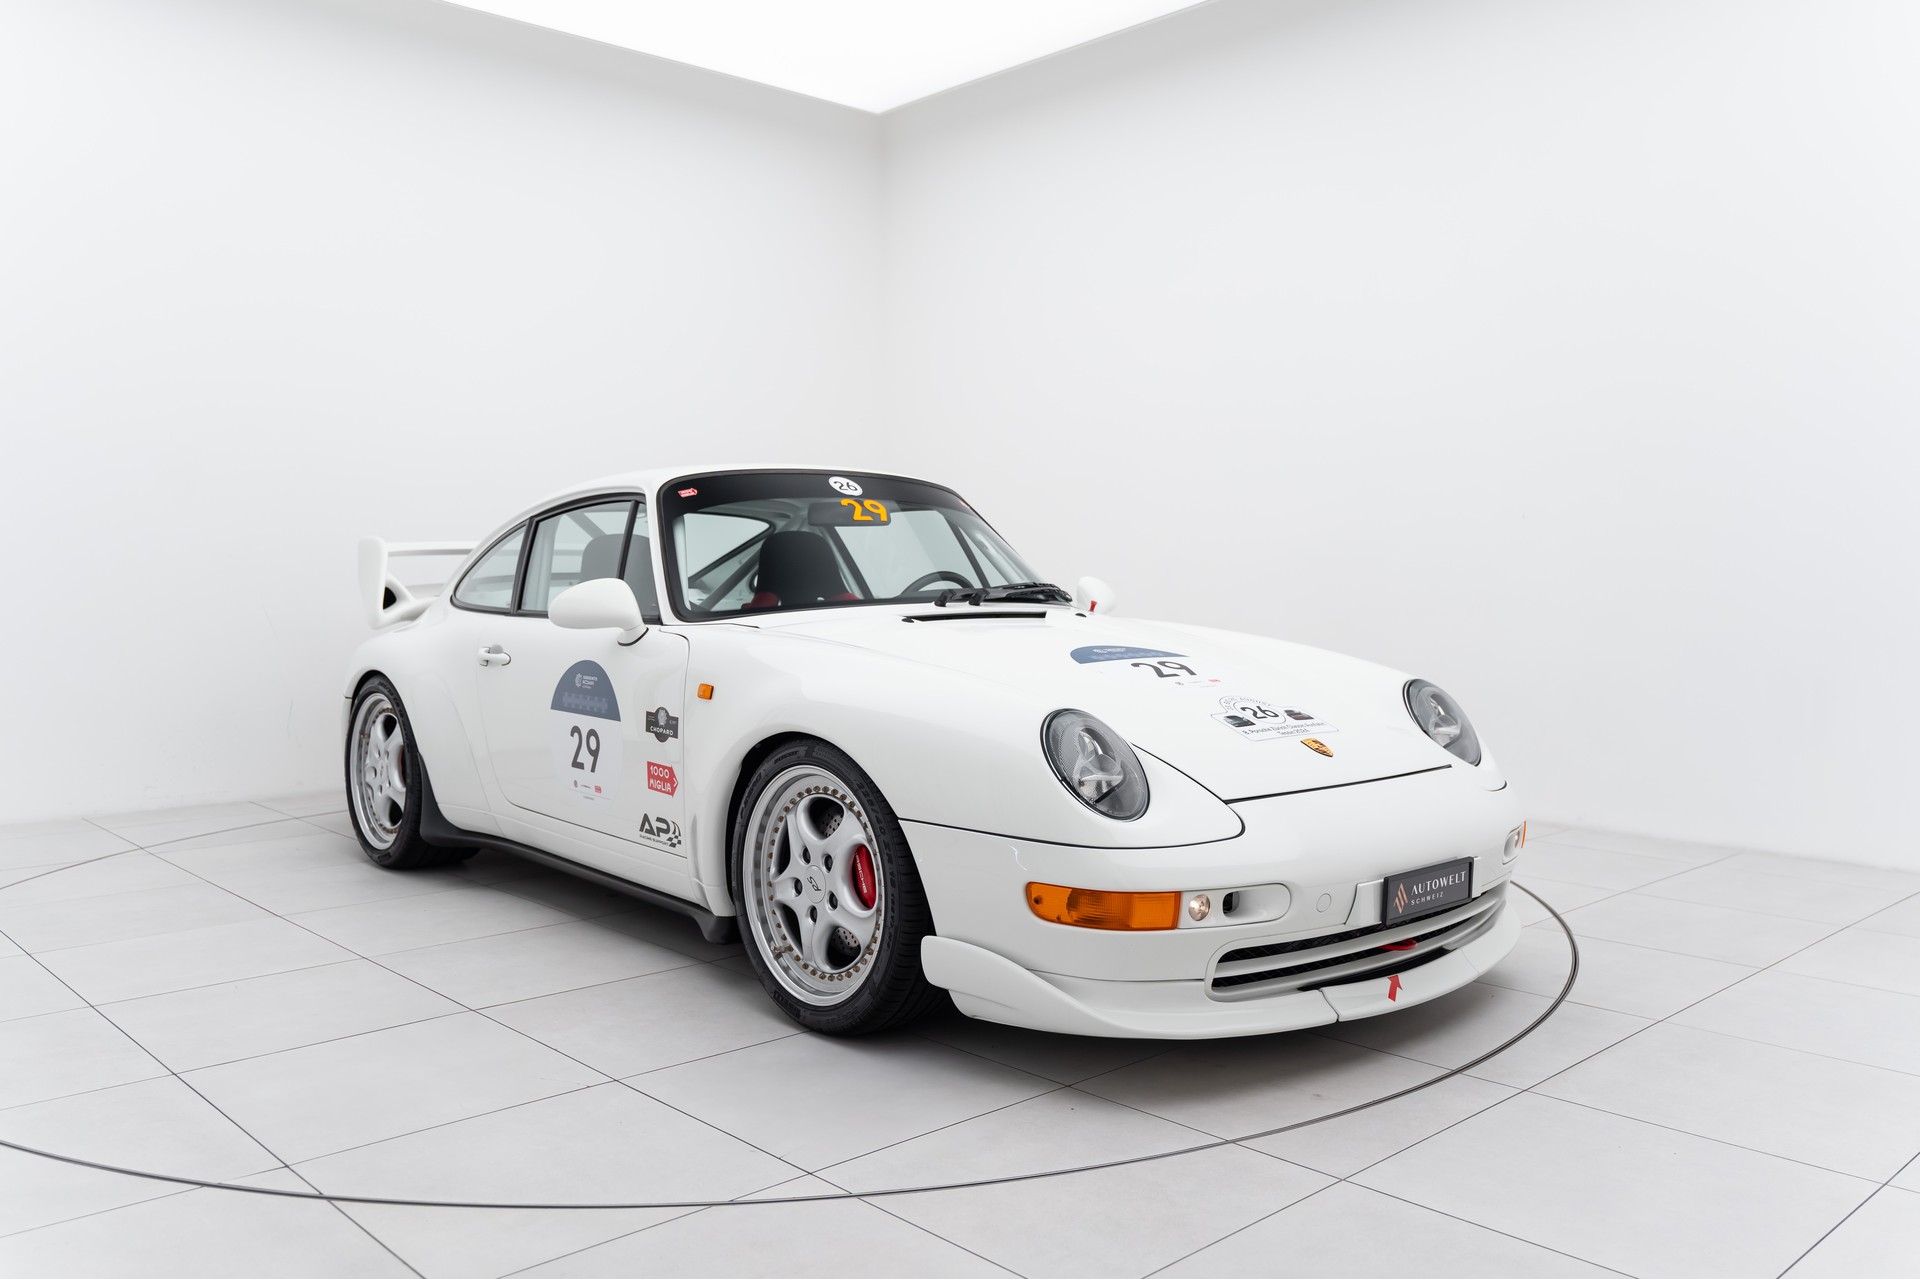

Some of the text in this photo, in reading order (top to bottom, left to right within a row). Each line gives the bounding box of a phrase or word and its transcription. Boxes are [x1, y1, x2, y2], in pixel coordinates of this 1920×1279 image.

[833, 481, 858, 491] 26
[840, 498, 888, 522] 29
[1131, 661, 1197, 678] 29
[1240, 705, 1280, 720] 26
[650, 725, 674, 736] CHOPARD
[570, 725, 600, 773] 29
[650, 766, 670, 779] 1000
[649, 779, 672, 793] MIGLIA
[855, 853, 868, 894] RSCHE
[1411, 871, 1466, 896] AUTOWELT
[1411, 891, 1444, 906] SCHWEIZ
